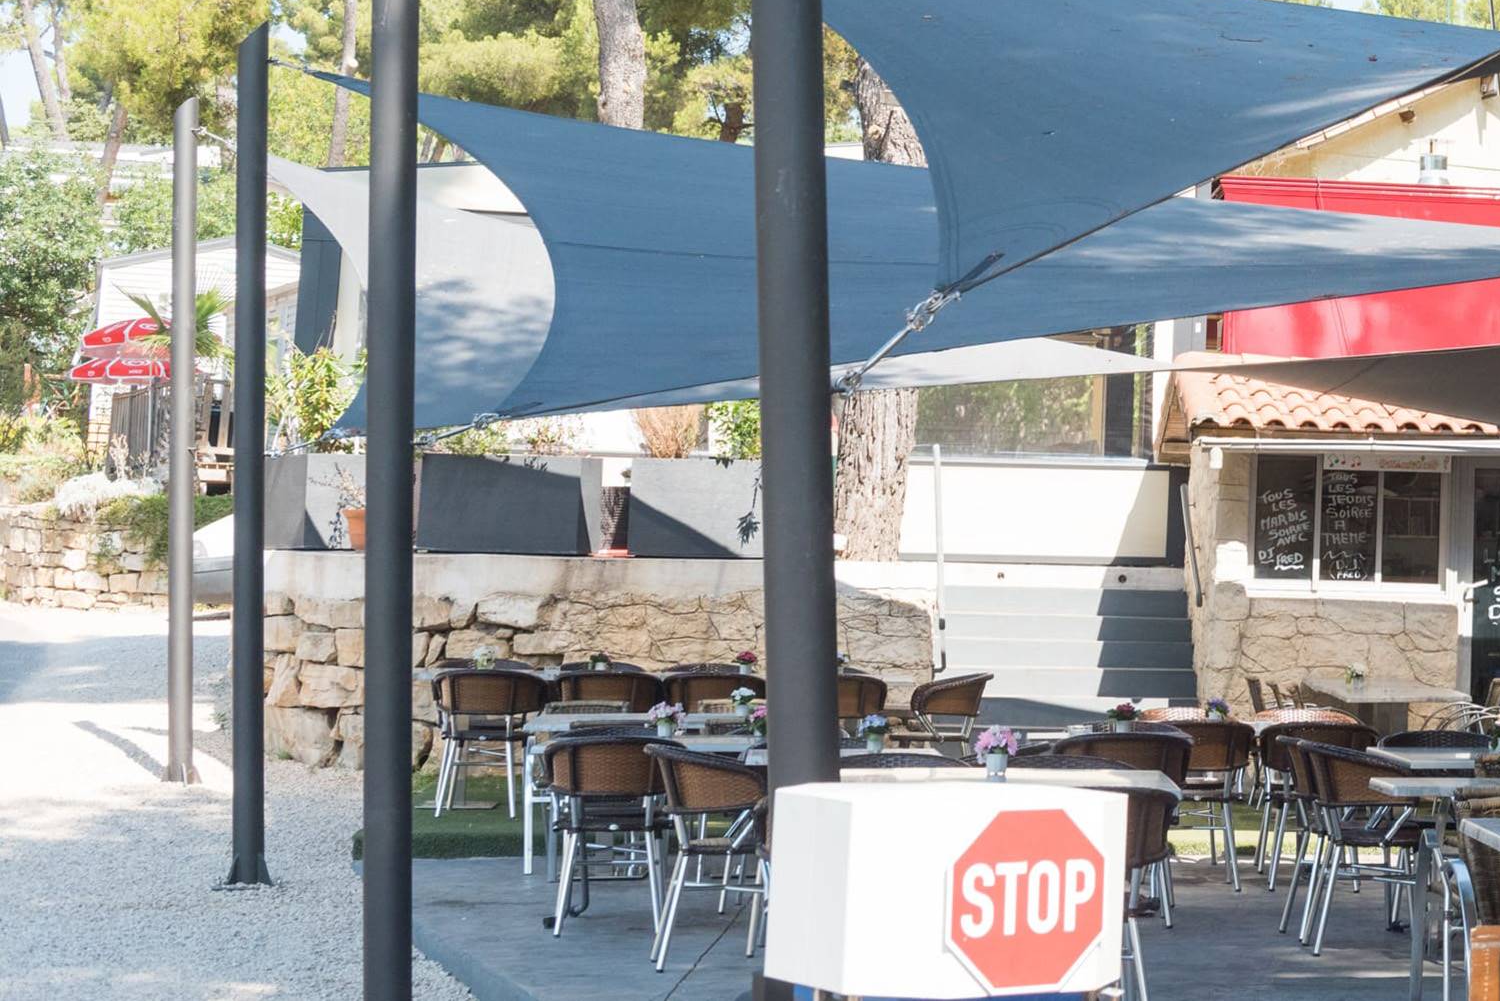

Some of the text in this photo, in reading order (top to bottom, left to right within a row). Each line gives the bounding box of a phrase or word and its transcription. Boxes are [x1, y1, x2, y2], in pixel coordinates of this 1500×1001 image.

[1259, 488, 1294, 504] TOUS
[1328, 484, 1356, 494] LES
[1272, 499, 1297, 511] LES
[1277, 532, 1309, 547] AVEC
[1258, 547, 1304, 566] DJ FRED
[960, 858, 1097, 939] STOP
